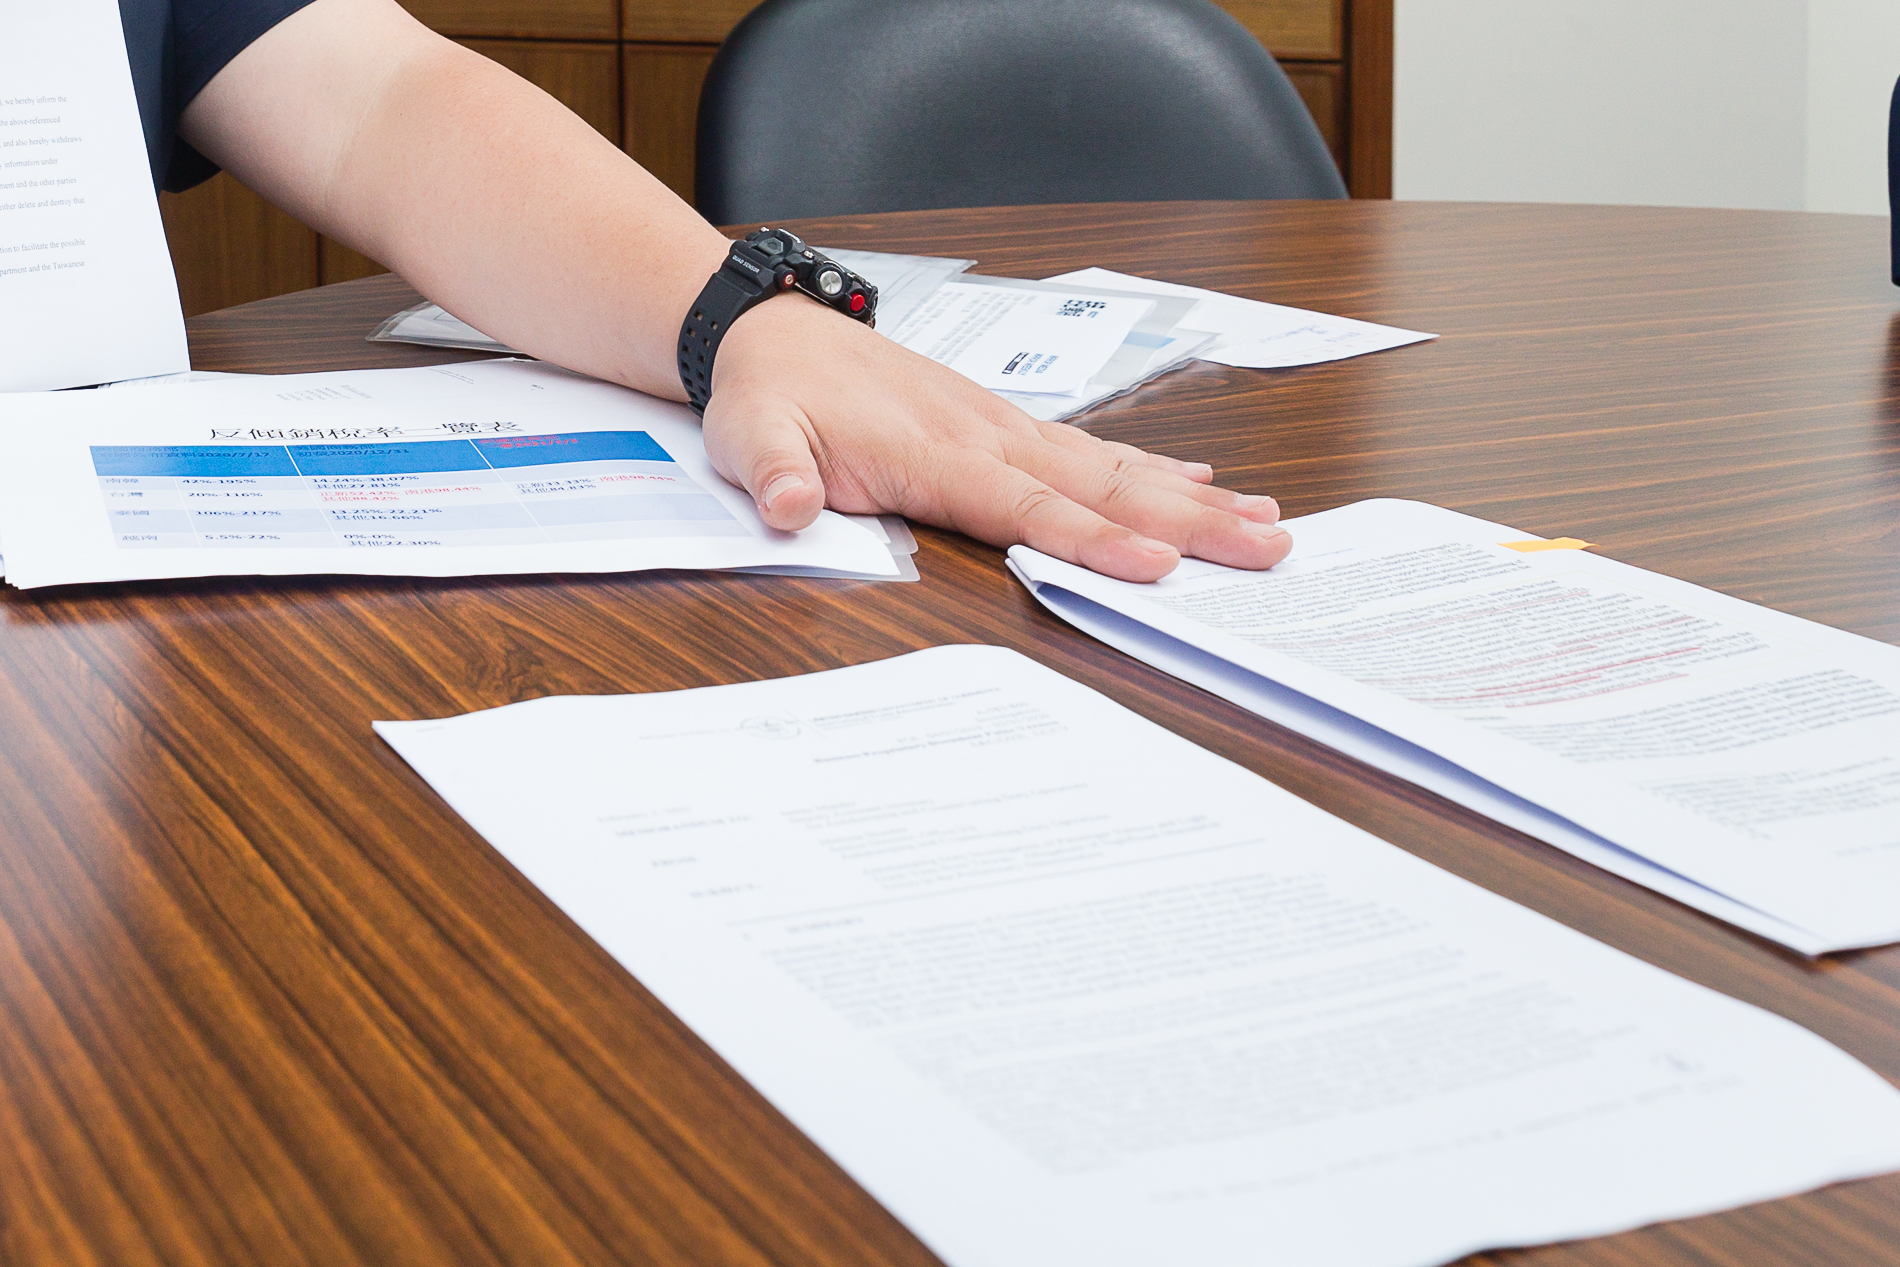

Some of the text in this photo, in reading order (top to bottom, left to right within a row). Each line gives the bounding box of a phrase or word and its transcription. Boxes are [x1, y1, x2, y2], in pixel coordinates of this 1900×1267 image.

[17, 201, 36, 209] delete
[37, 199, 49, 207] and
[20, 243, 48, 251] facilitate
[60, 238, 85, 248] possible
[28, 264, 41, 272] and
[52, 261, 85, 269] Taiwanese
[732, 254, 760, 274] QUAD SENSOR
